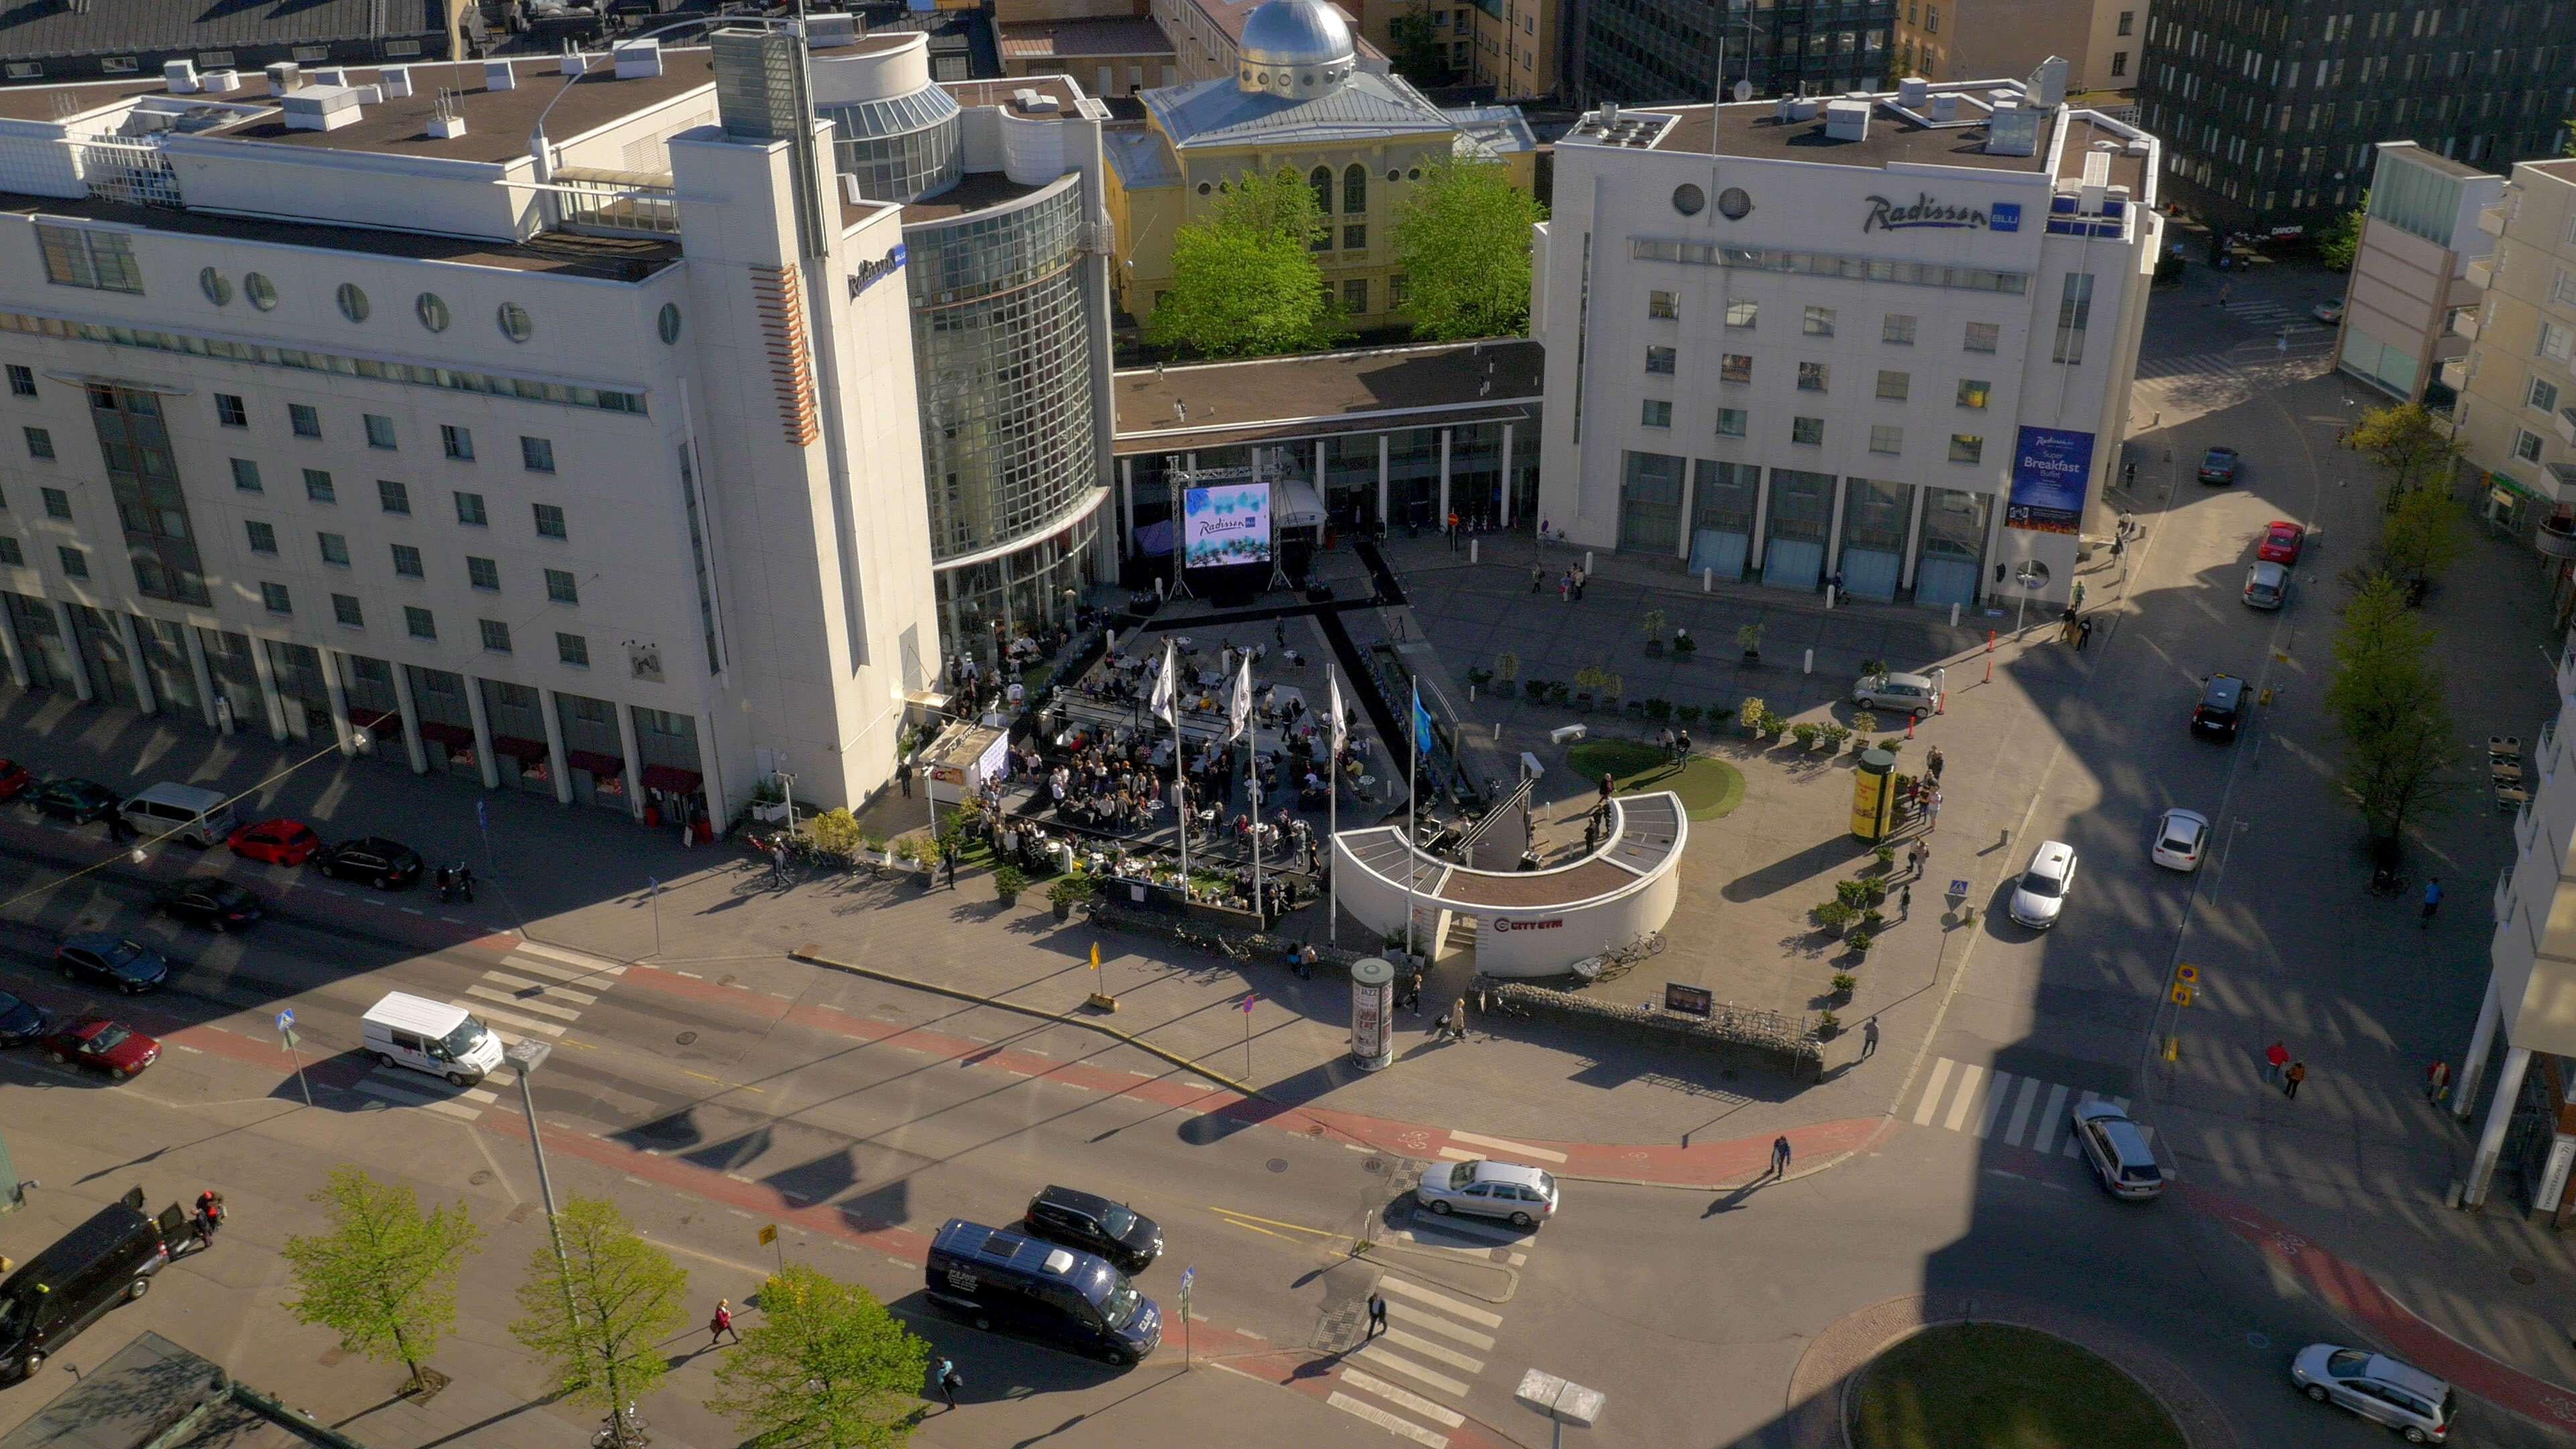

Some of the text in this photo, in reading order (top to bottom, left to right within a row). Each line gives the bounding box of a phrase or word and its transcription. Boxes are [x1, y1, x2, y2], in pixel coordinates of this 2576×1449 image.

[1864, 192, 2018, 233] Radisson BLU
[847, 252, 906, 306] Radisson BLU
[2043, 450, 2064, 459] Super
[2024, 456, 2080, 473] Breakfast
[2040, 470, 2061, 478] Buffet
[1199, 517, 1244, 536] Radisson
[1361, 987, 1377, 996] JAZZ
